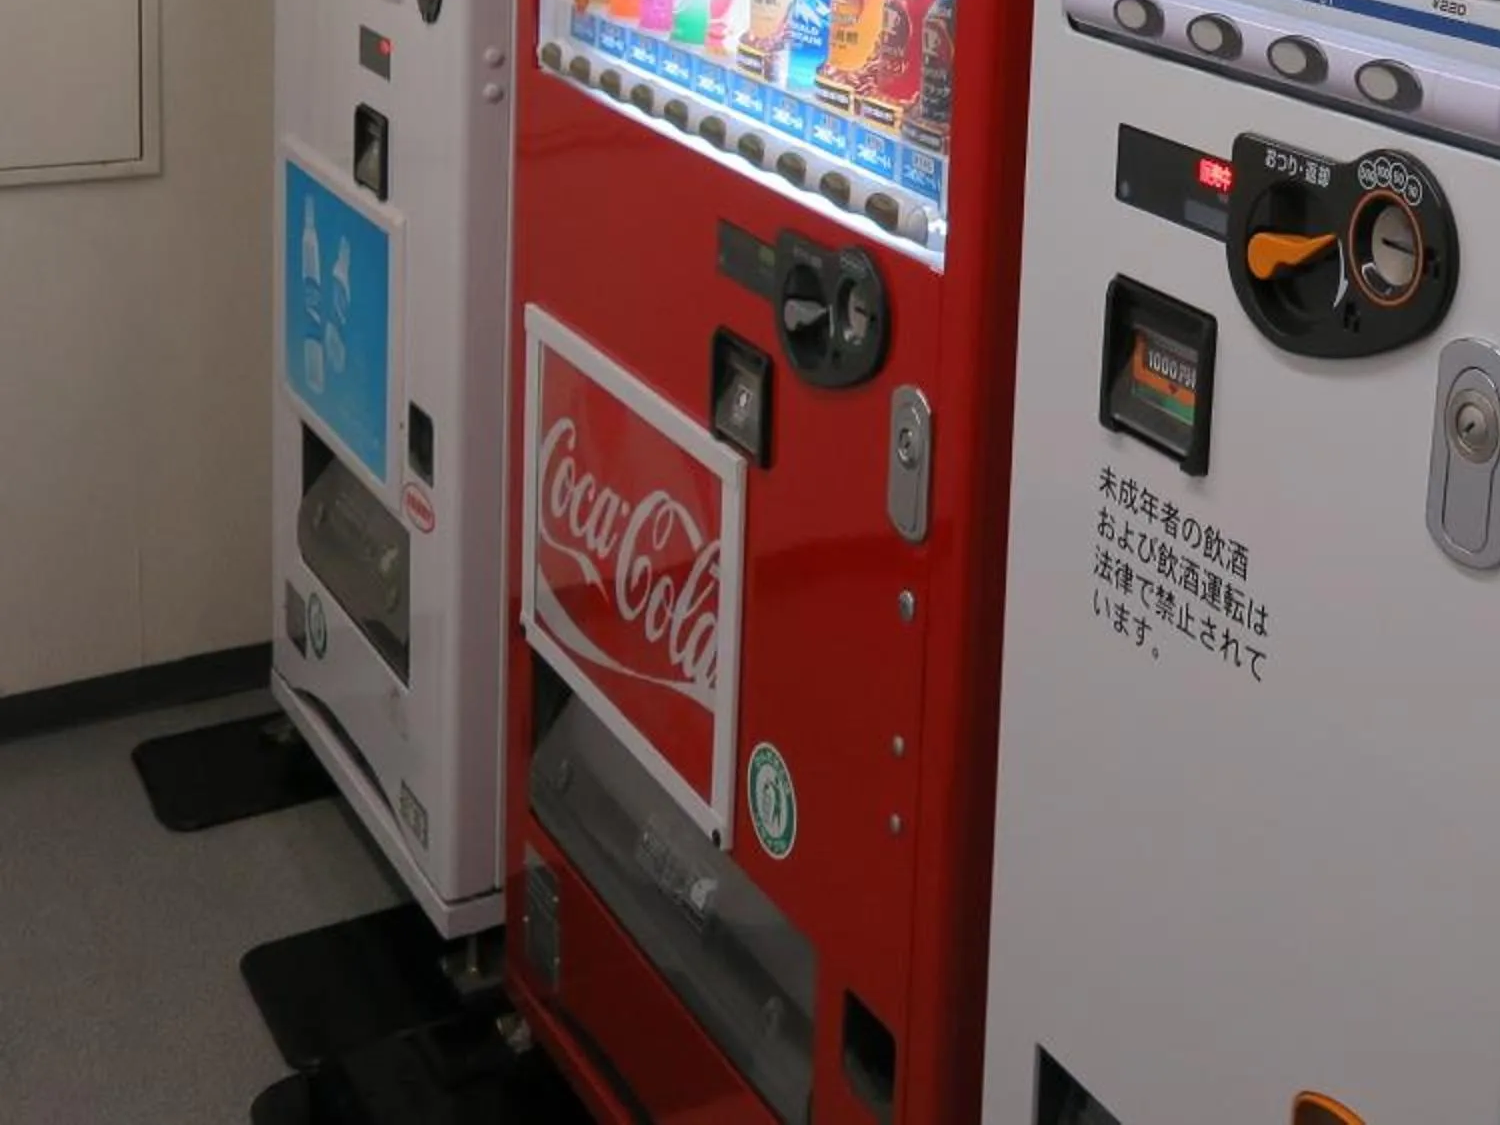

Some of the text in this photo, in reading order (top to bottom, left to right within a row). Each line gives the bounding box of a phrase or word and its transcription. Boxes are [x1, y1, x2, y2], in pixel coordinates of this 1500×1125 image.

[541, 417, 722, 690] Coca-Cola
[1097, 509, 1269, 638] および飲酒運転は
[1099, 465, 1250, 583] 未成年者の飲酒
[1092, 589, 1160, 662] います。
[1093, 544, 1268, 684] 法律で禁止されて
